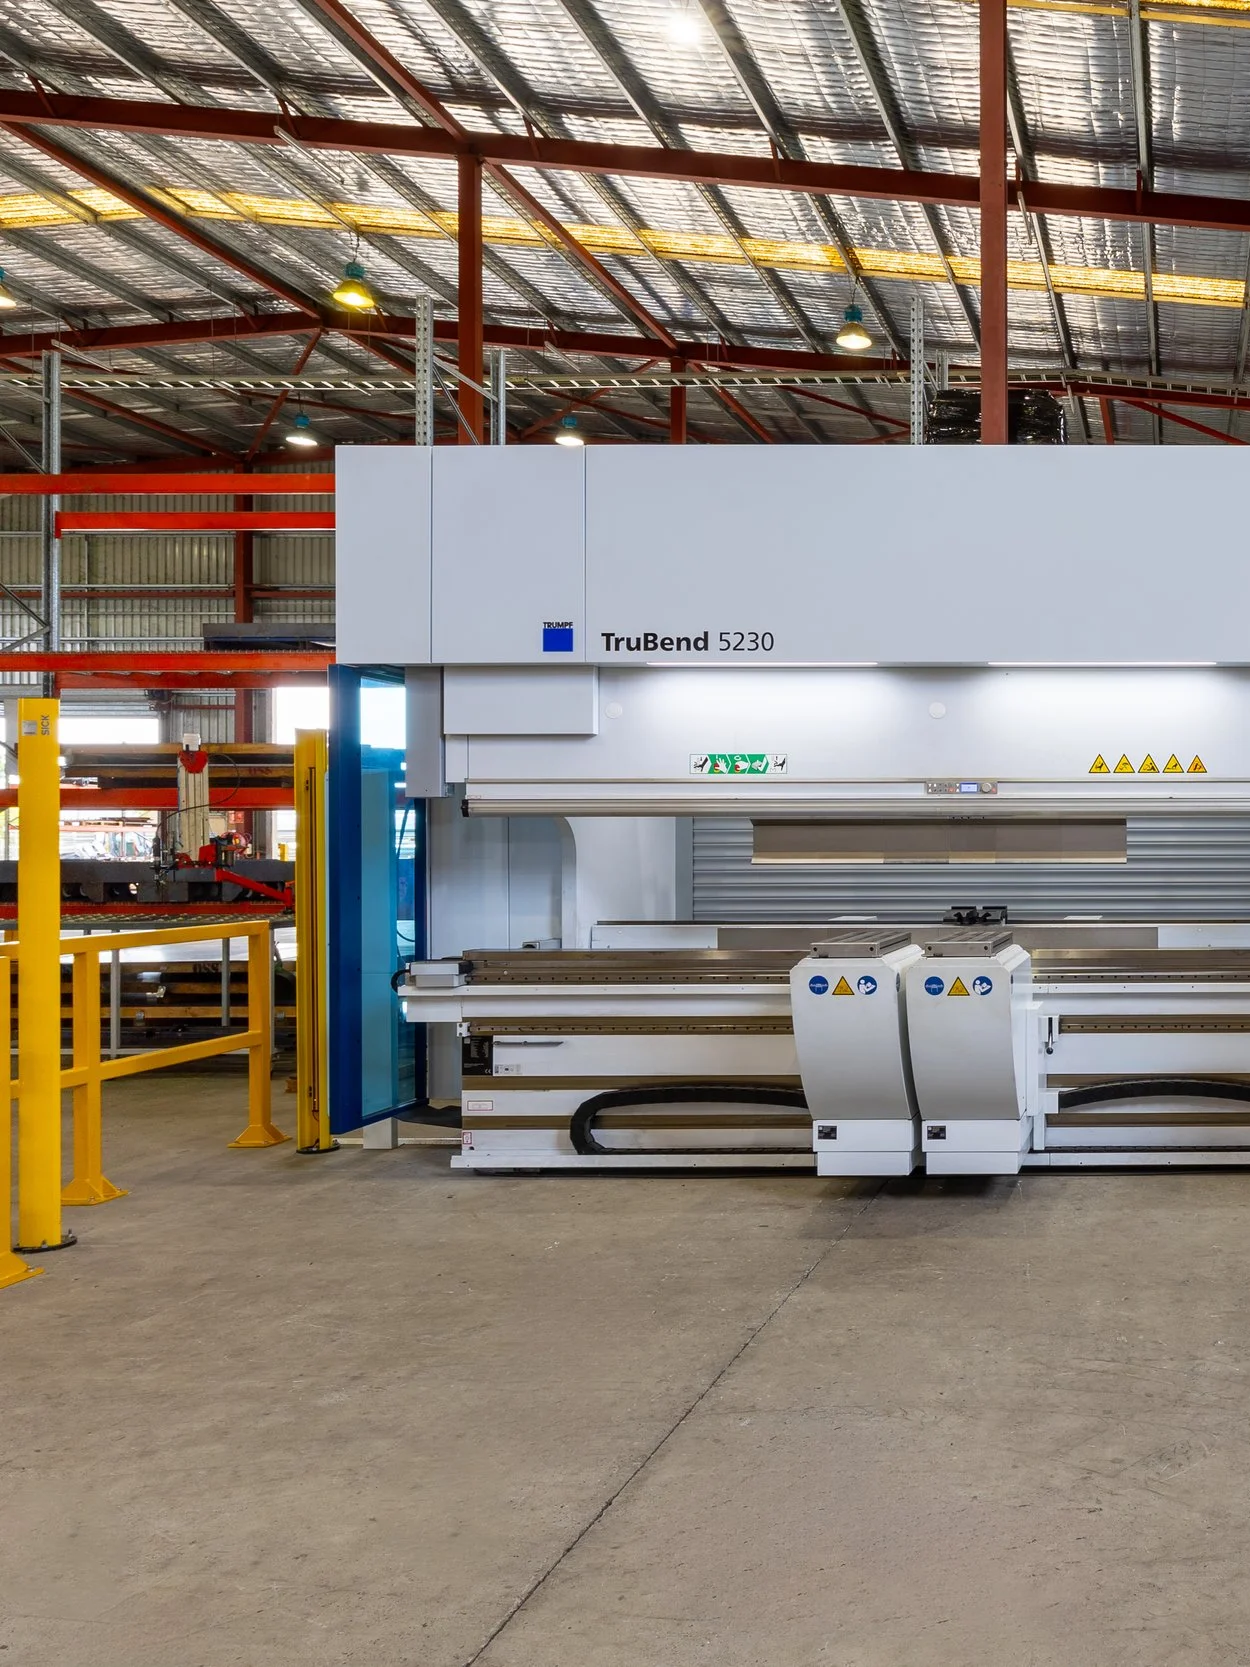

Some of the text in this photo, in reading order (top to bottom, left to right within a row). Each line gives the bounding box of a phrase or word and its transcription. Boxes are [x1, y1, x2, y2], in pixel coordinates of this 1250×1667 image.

[601, 631, 774, 651] TruBend 5230
[41, 715, 50, 736] SICK
